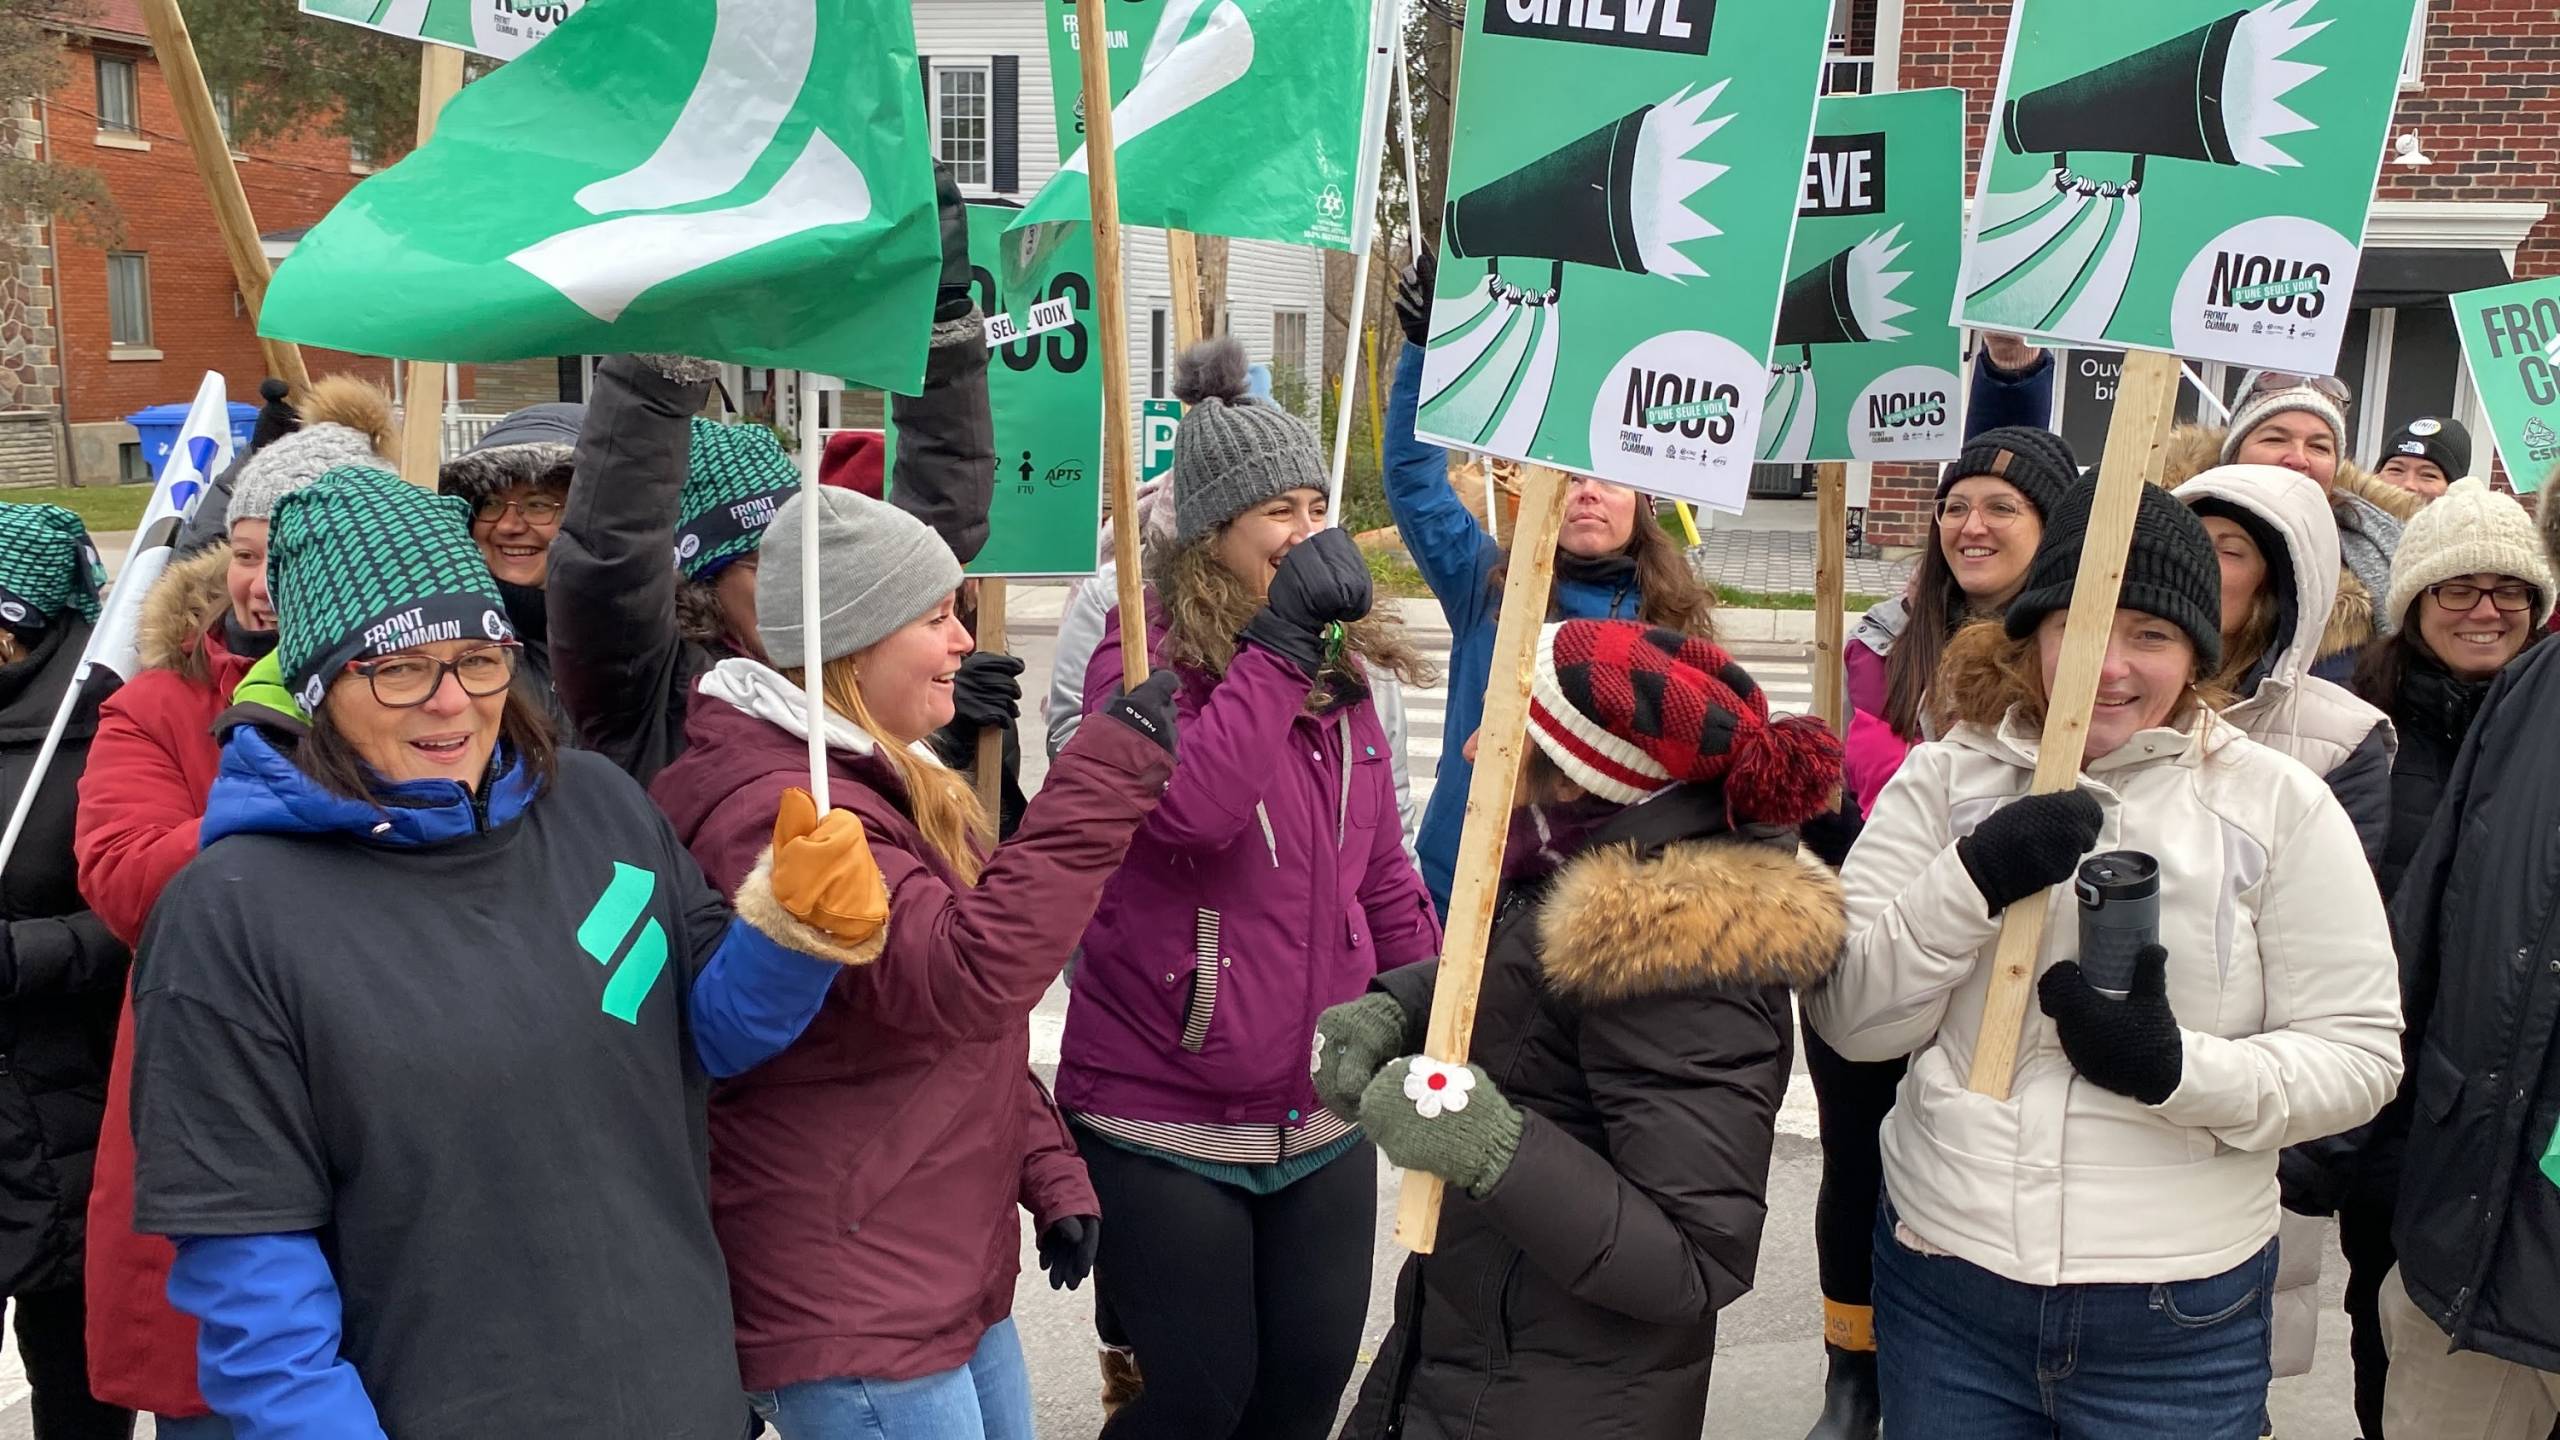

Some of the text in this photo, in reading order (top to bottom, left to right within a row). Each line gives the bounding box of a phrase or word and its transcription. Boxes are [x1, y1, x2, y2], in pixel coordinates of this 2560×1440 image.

[1799, 149, 1872, 209] EVE
[2207, 251, 2330, 319] NOUS
[2235, 279, 2314, 301] D'UNE SEULE VOIX
[970, 265, 1091, 374] OUS
[1033, 303, 1067, 328] VOIX
[2203, 309, 2228, 321] FRONT
[2481, 297, 2560, 358] FRO
[2080, 358, 2123, 377] Ouv
[2095, 381, 2115, 400] bi
[1622, 367, 1740, 445] NOUS
[1648, 401, 1724, 422] D'UNE SEULE VOIX
[1869, 391, 1946, 428] NOUS
[1145, 416, 1179, 468] P
[1619, 430, 1643, 444] FRONT
[1045, 468, 1083, 481] APTS
[729, 495, 775, 520] FRONT
[363, 606, 424, 648] FRONT
[376, 619, 461, 656] COMMUN
[1125, 706, 1157, 733] HEAD
